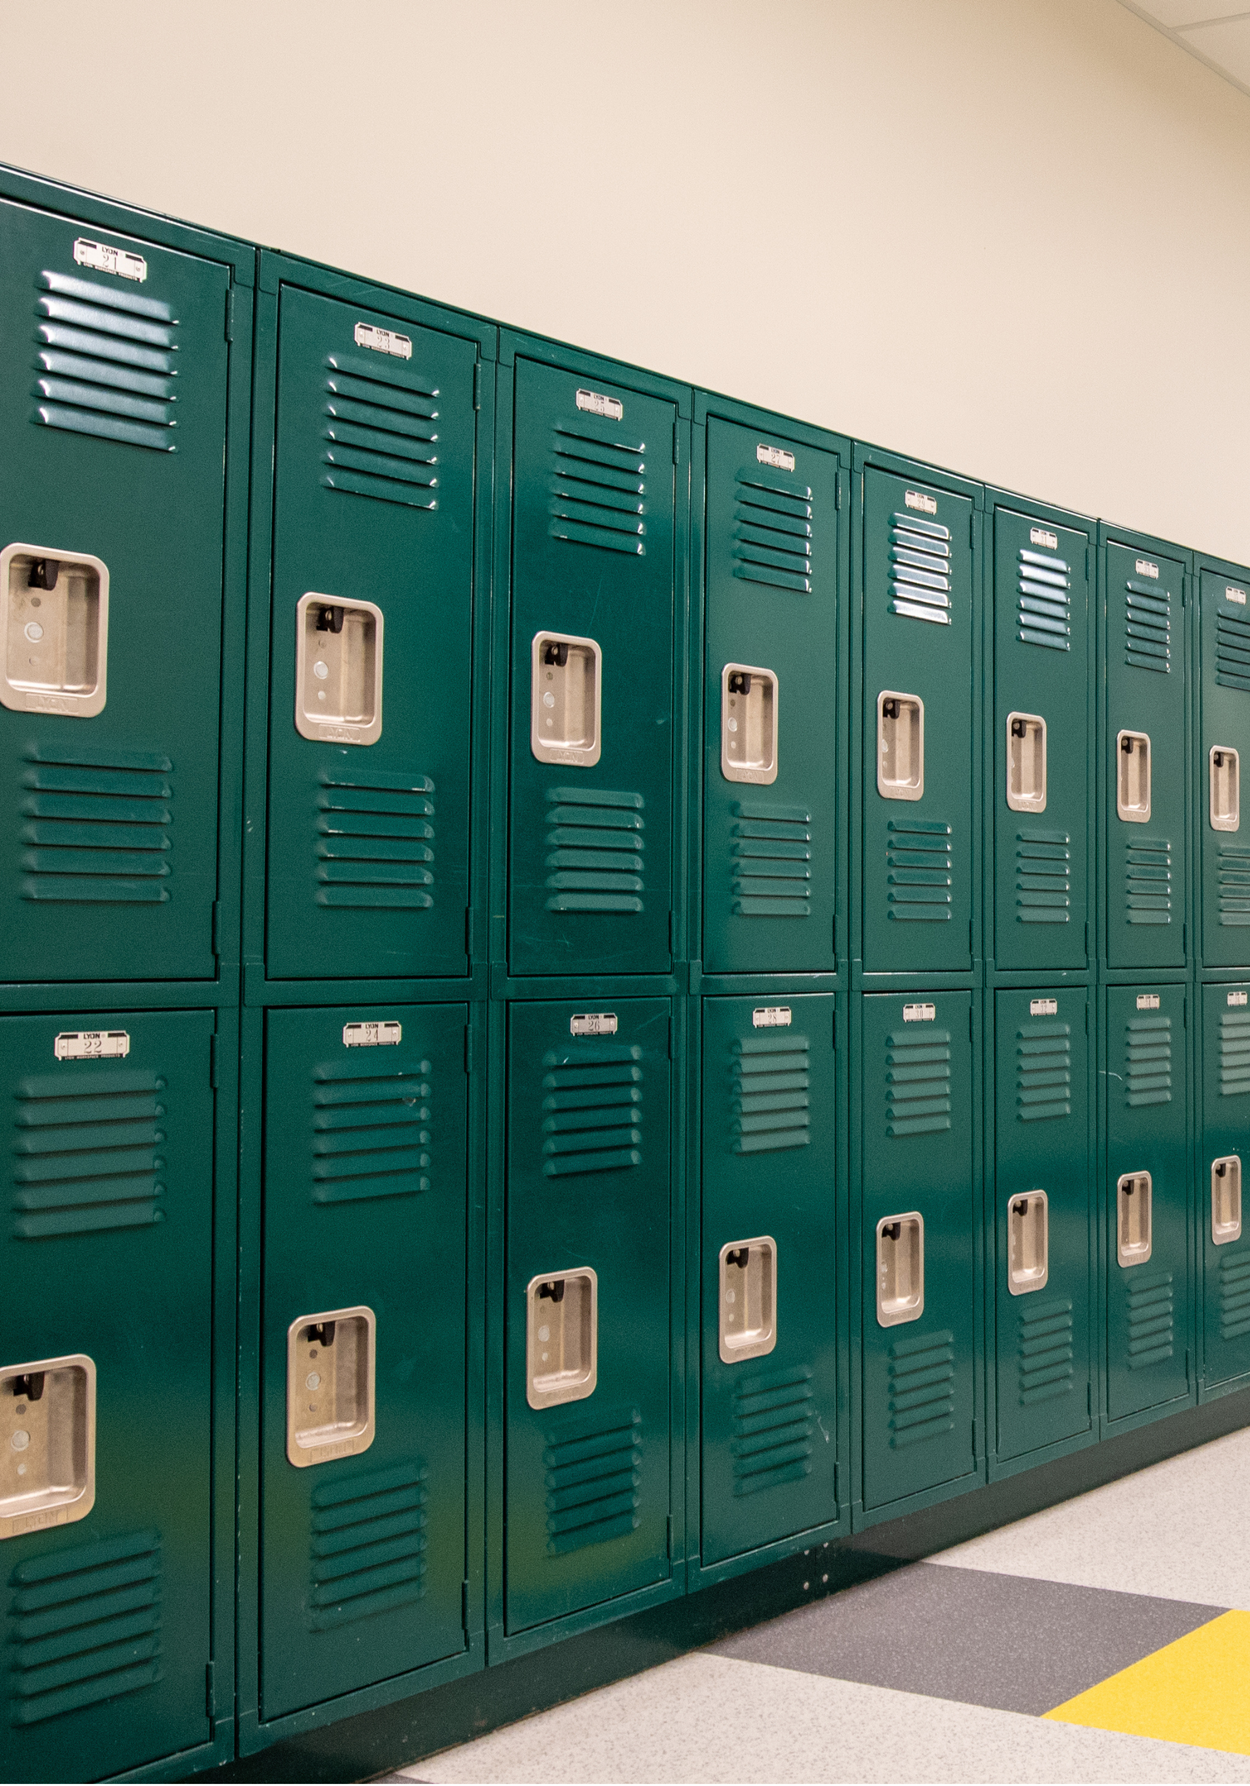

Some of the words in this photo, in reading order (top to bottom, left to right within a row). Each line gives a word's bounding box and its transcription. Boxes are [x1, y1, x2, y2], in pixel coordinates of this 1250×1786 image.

[102, 254, 117, 270] 21
[377, 336, 390, 350] 23
[588, 1020, 600, 1031] 26
[366, 1028, 379, 1042] 24
[84, 1040, 102, 1054] 22
